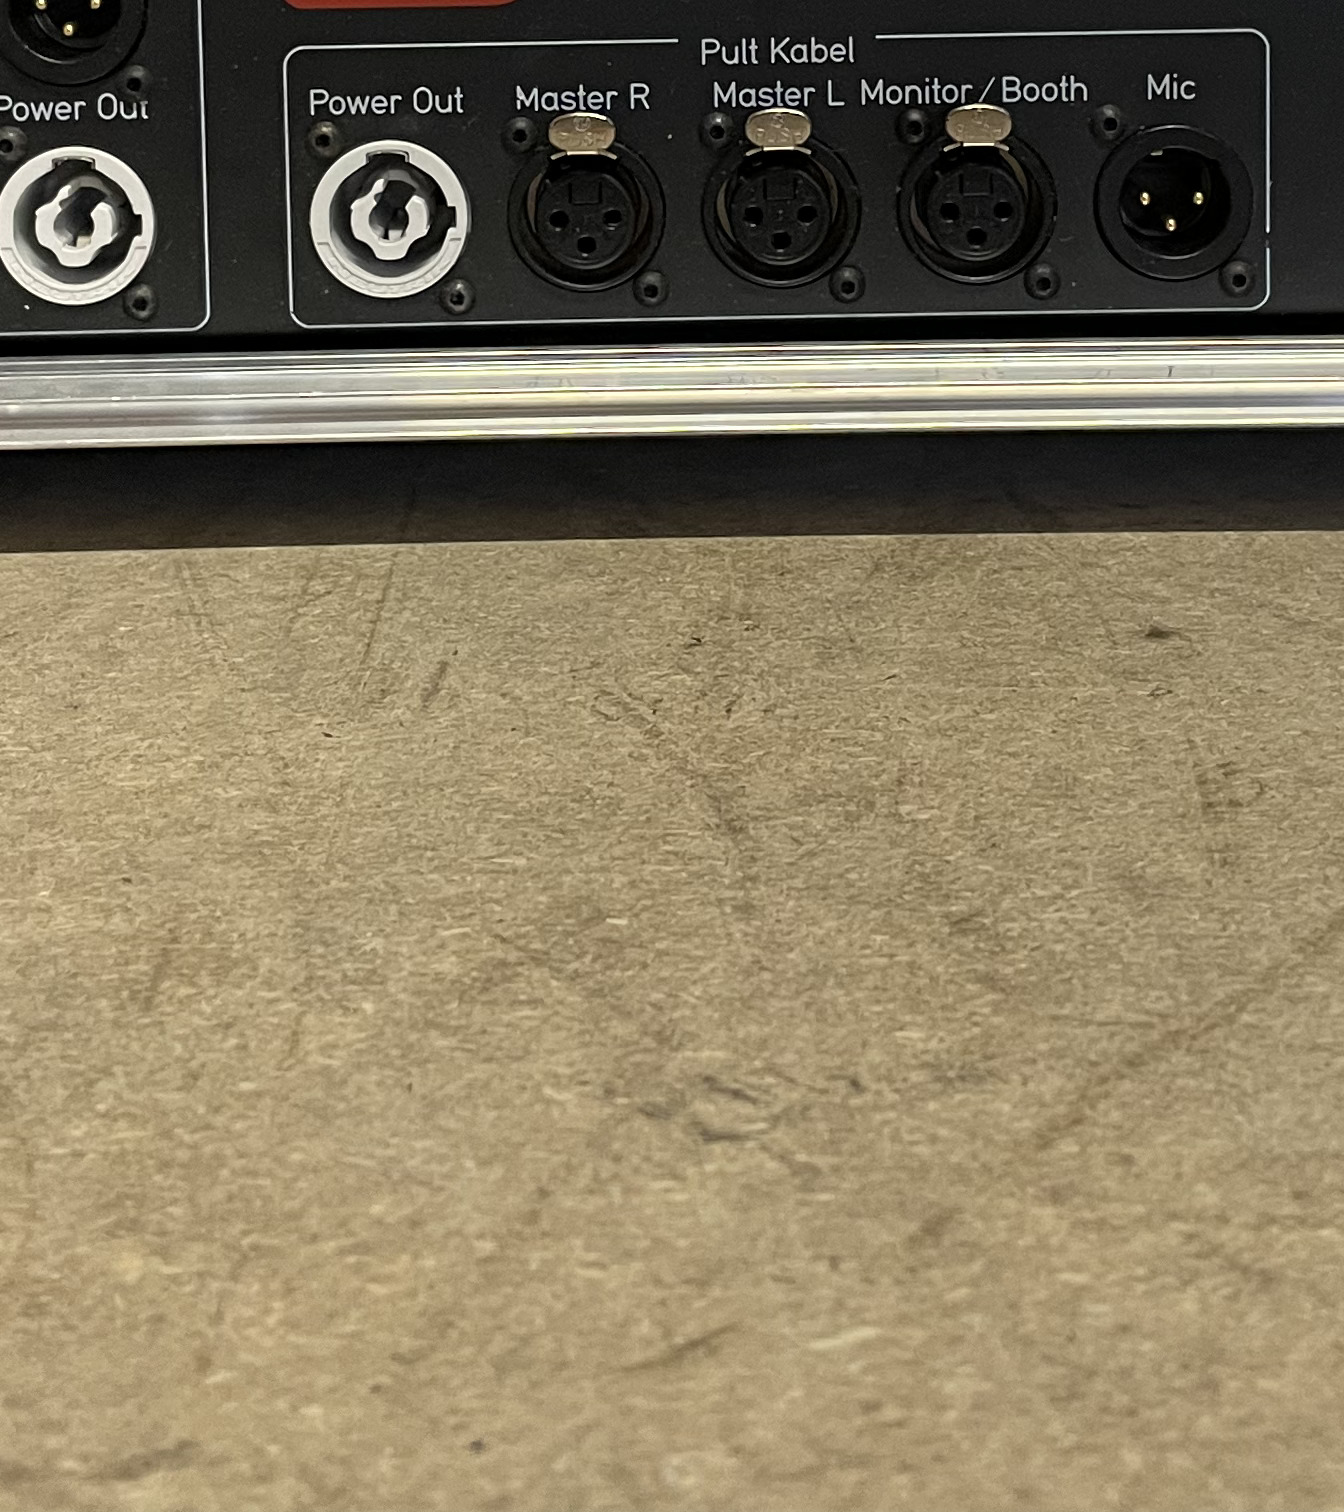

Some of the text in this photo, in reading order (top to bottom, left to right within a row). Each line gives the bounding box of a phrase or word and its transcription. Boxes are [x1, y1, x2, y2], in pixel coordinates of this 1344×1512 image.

[701, 36, 855, 66] Pult Kabel
[309, 86, 464, 116] Power Out
[516, 82, 650, 112] Master R
[713, 79, 846, 108] Master L
[1147, 73, 1196, 101] Mic
[97, 92, 149, 120] Out
